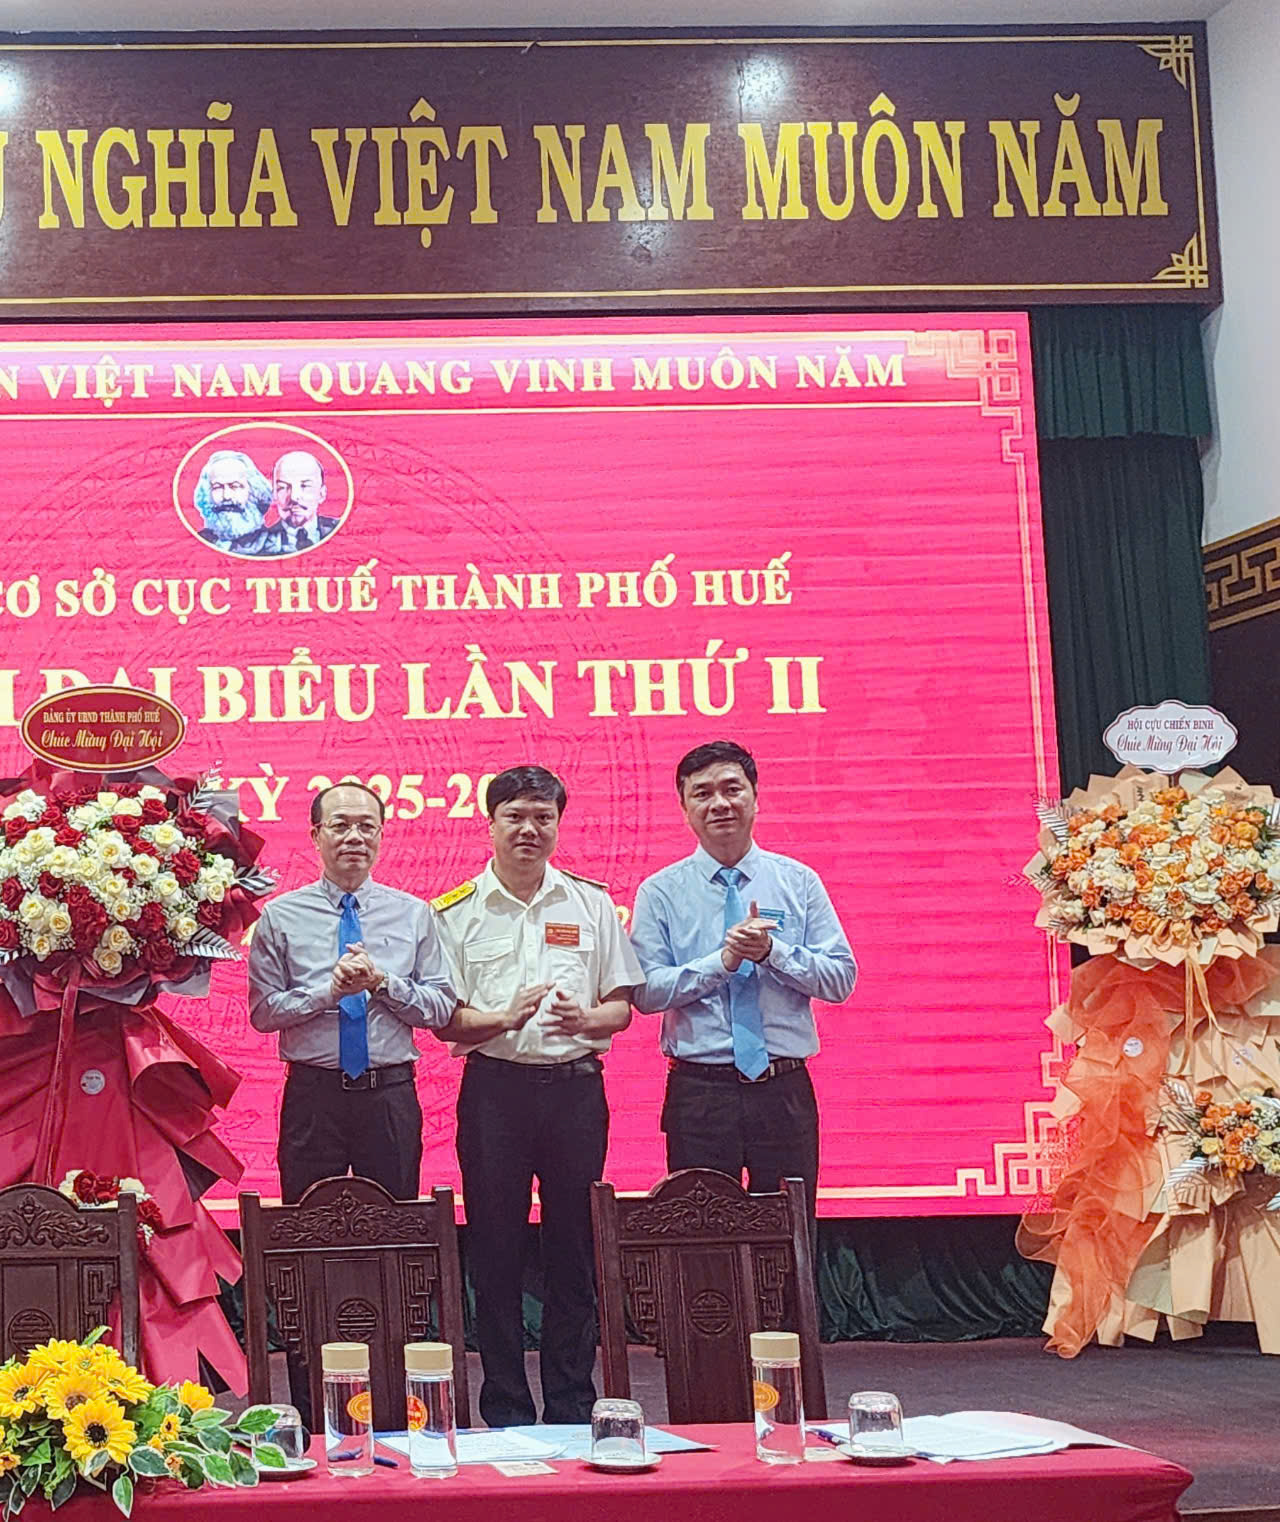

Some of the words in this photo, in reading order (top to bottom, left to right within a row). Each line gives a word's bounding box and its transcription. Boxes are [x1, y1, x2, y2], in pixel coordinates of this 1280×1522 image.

[36, 101, 299, 229] NGHĨA
[311, 97, 508, 249] VIỆT
[534, 122, 711, 224] NAM
[740, 92, 965, 221] MUÔN
[989, 92, 1169, 218] NĂM
[37, 355, 154, 408] VIỆT
[172, 362, 282, 398] NAM
[299, 361, 473, 403] QUANG
[489, 357, 615, 393] VINH
[631, 346, 777, 391] MUÔN
[795, 345, 906, 389] NĂM
[56, 567, 117, 617] SỞ
[132, 577, 231, 625] CỤC
[247, 558, 380, 614] THUẾ
[394, 563, 563, 611] THÀNH
[577, 553, 678, 608] PHỐ
[692, 551, 793, 606] HUẾ
[199, 646, 380, 724] BIỂU
[402, 644, 559, 721] LẦN
[578, 639, 749, 718] THỨ
[765, 656, 827, 714] II
[43, 708, 63, 722] ĐẢNG
[78, 711, 97, 722] UBND
[100, 708, 125, 722] THÀNH
[127, 707, 143, 722] PHỐ
[144, 706, 160, 722] HUẾ
[1128, 719, 1142, 732] HỘI
[1164, 716, 1191, 730] CHIẾN
[1193, 720, 1214, 729] BINH
[41, 729, 70, 748] Chúc
[72, 729, 107, 751] Mừng
[110, 729, 134, 752] Đại
[138, 729, 163, 752] Hội
[1117, 734, 1141, 752] Chúc
[1143, 734, 1172, 754] Mừng
[1176, 735, 1198, 755] Đại
